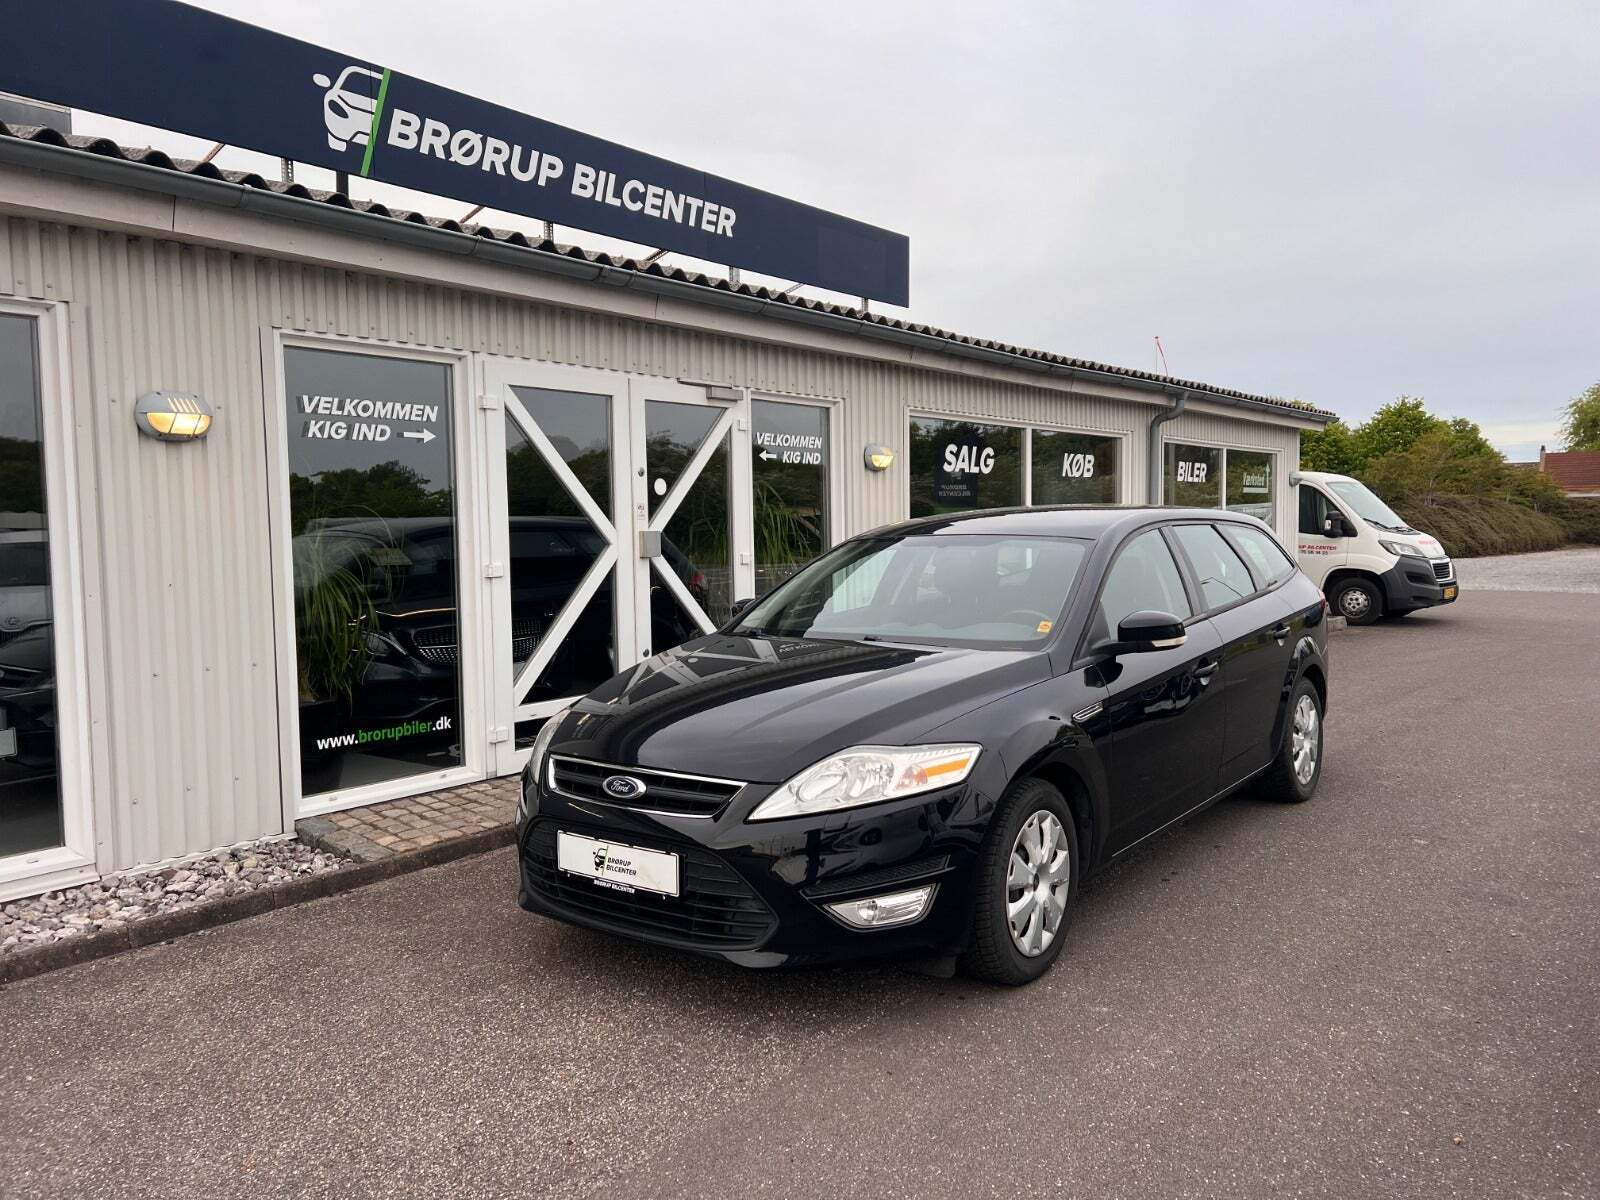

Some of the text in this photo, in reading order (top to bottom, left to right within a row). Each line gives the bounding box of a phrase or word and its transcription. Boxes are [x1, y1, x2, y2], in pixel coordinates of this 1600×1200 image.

[387, 108, 737, 237] BRØRUP BILCENTER
[302, 394, 439, 423] VELKOMMEN
[308, 420, 391, 442] KIG IND
[756, 432, 823, 449] VELKOMMEN
[782, 451, 821, 465] KIG IND
[943, 443, 995, 475] SALG
[1062, 452, 1095, 478] KØB
[1177, 461, 1208, 483] BILER
[317, 716, 452, 750] www.brorupbiler.dk
[610, 780, 631, 793] Ford
[606, 864, 637, 876] BILCENTER
[607, 857, 632, 867] BRØRUP
